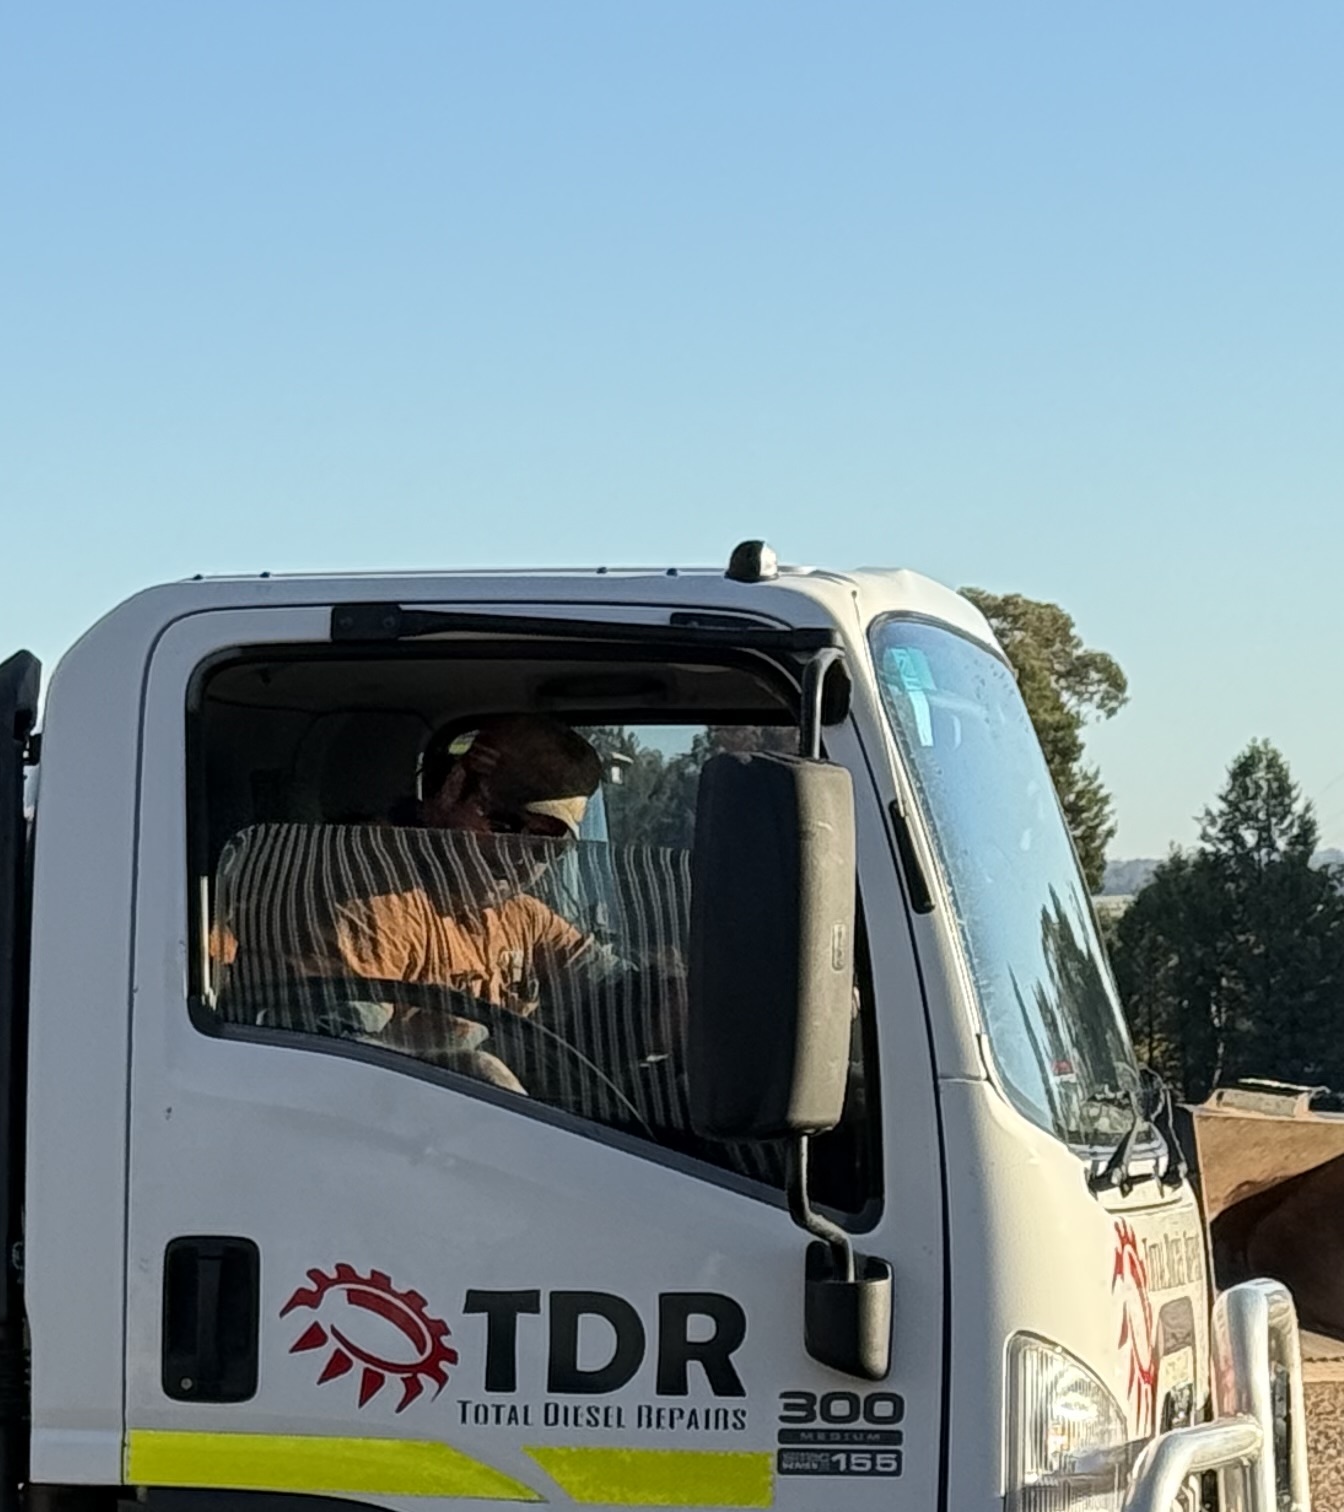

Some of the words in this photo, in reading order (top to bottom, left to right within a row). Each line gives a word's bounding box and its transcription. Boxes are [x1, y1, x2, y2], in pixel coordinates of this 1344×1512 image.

[463, 1289, 747, 1398] TDR
[457, 1400, 533, 1427] TOTAL
[543, 1402, 626, 1429] DIESEL
[637, 1404, 747, 1431] REPAIRS
[778, 1391, 905, 1425] 300
[831, 1453, 898, 1473] 155
